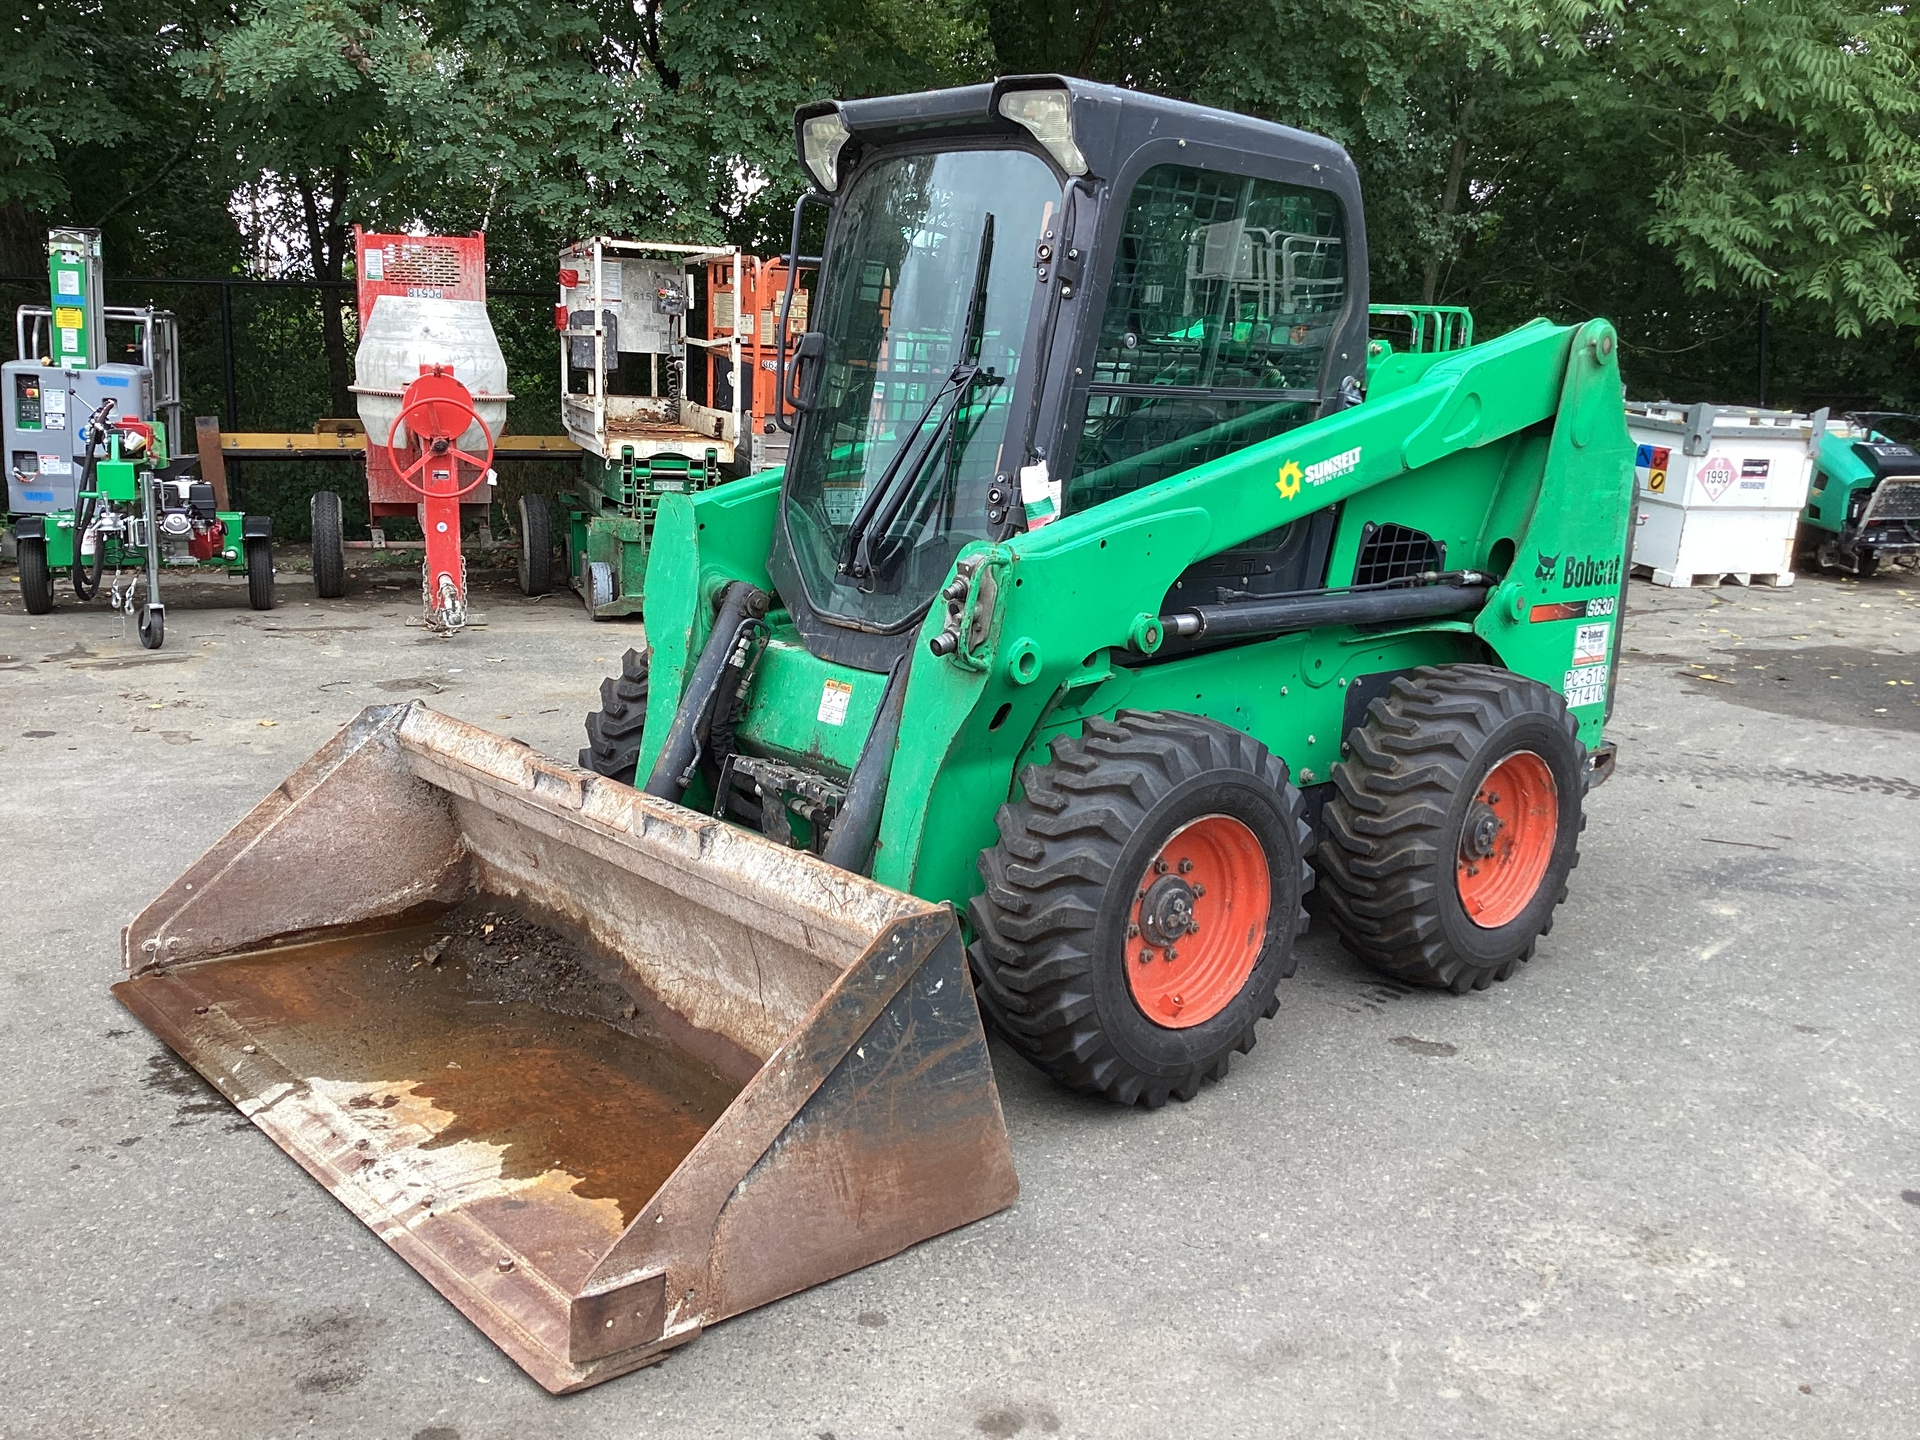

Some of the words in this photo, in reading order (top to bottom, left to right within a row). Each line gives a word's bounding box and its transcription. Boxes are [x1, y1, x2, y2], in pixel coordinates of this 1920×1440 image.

[1304, 445, 1362, 484] SUNBELT
[1653, 451, 1669, 467] 3
[1313, 465, 1355, 488] RENTALS
[1650, 472, 1664, 490] 0
[1706, 471, 1729, 484] 1993
[1562, 555, 1621, 590] Bobcat
[1587, 596, 1616, 618] S630
[1565, 666, 1606, 688] PC-518
